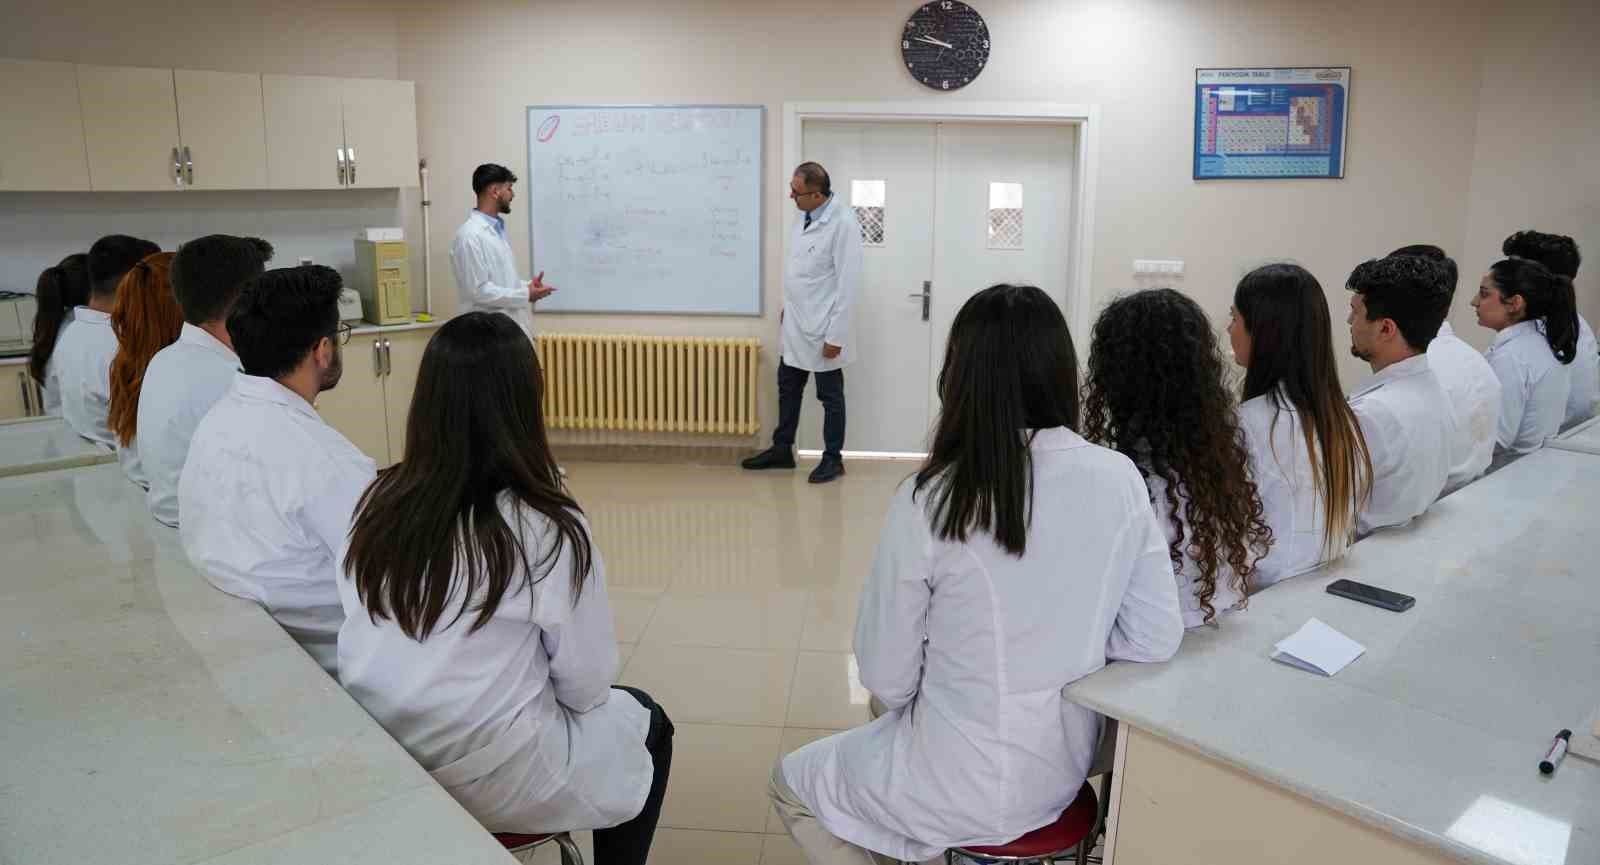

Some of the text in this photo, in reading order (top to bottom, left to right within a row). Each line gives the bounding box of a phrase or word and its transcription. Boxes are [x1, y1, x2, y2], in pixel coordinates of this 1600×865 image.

[941, 1, 952, 10] 12
[903, 40, 909, 49] 9
[982, 40, 989, 49] 3
[942, 80, 949, 89] 6
